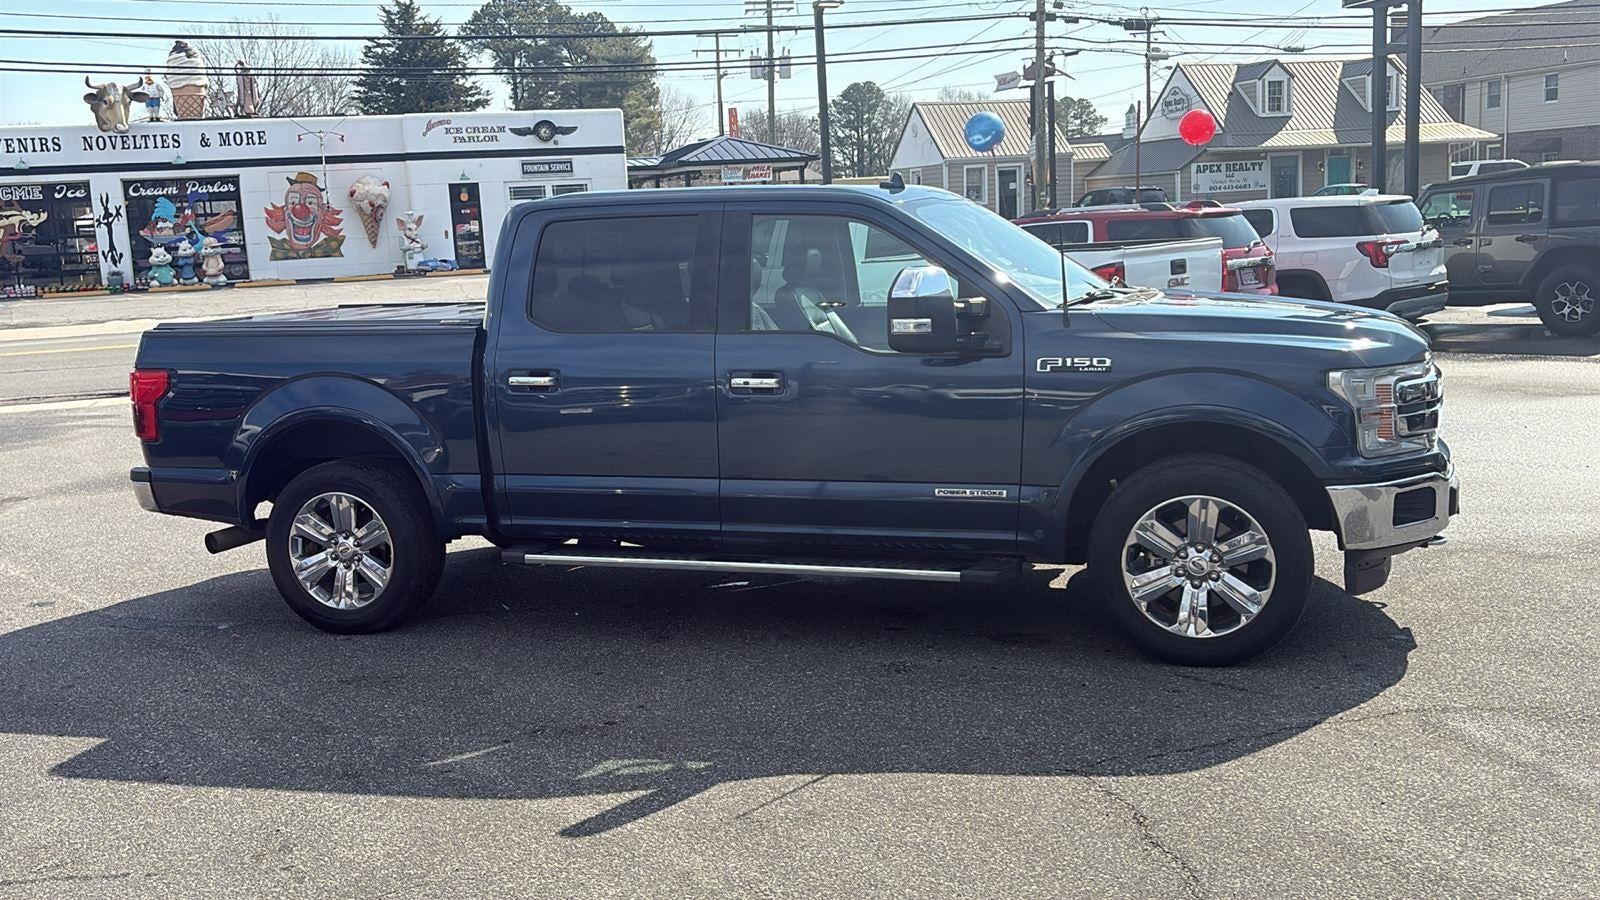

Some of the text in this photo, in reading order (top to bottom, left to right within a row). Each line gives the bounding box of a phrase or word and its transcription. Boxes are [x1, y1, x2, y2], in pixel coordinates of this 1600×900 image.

[444, 126, 506, 135] ICE CREAM
[0, 130, 267, 153] ENIRS NOVELTIES & MORE
[453, 135, 499, 143] PARLOR
[523, 163, 571, 172] FOUNTAIN SERVICE
[1195, 162, 1264, 174] APEX REALTY
[54, 185, 87, 198] Ice
[128, 181, 236, 196] Cream Parlor
[1167, 277, 1190, 288] GMC
